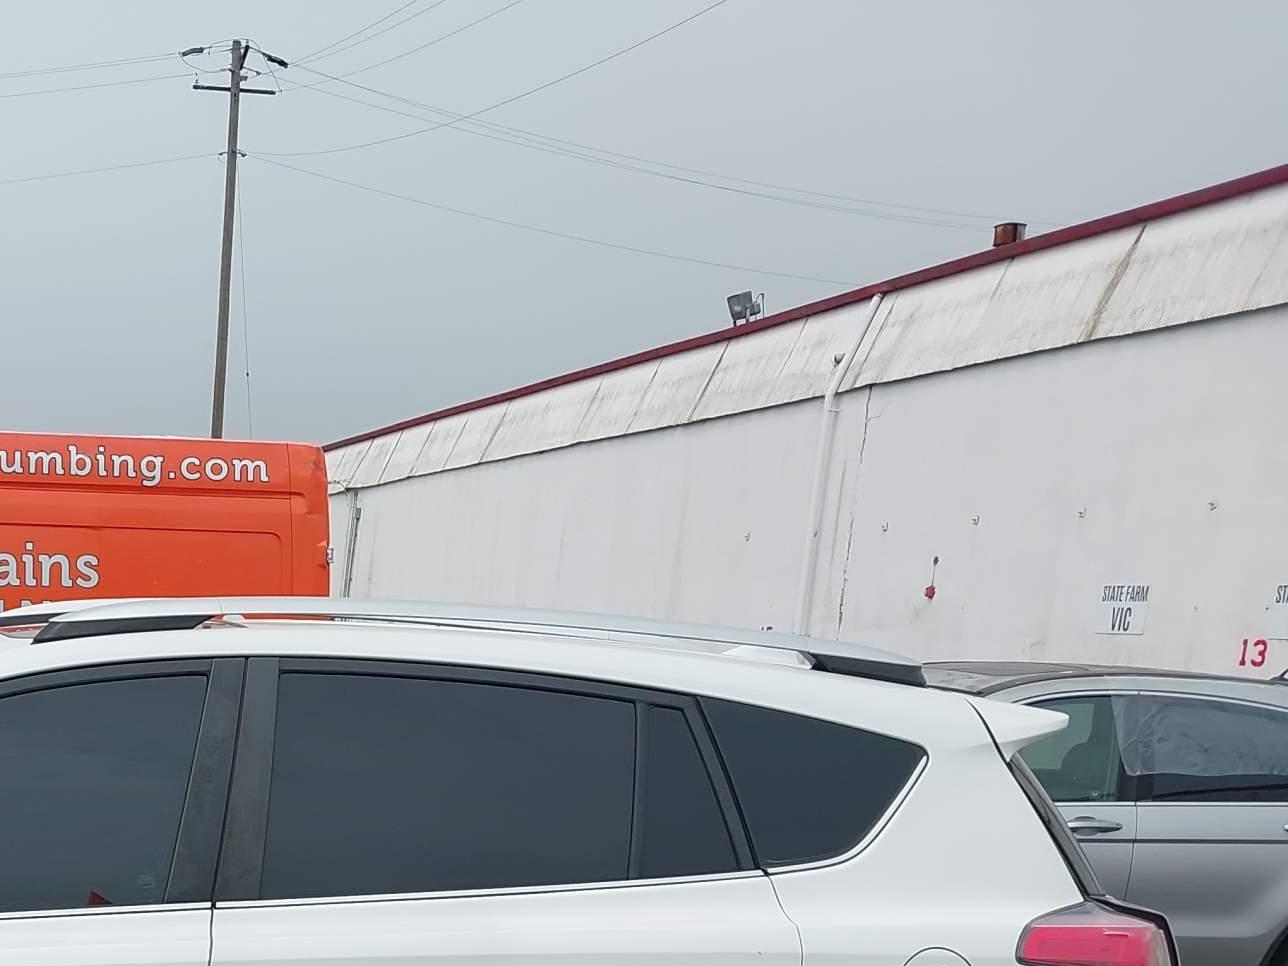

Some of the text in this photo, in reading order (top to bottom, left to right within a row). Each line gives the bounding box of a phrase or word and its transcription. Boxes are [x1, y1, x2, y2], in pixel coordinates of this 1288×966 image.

[1101, 585, 1150, 602] STATE FARM
[1111, 606, 1132, 632] VIC
[1238, 638, 1268, 667] 13
